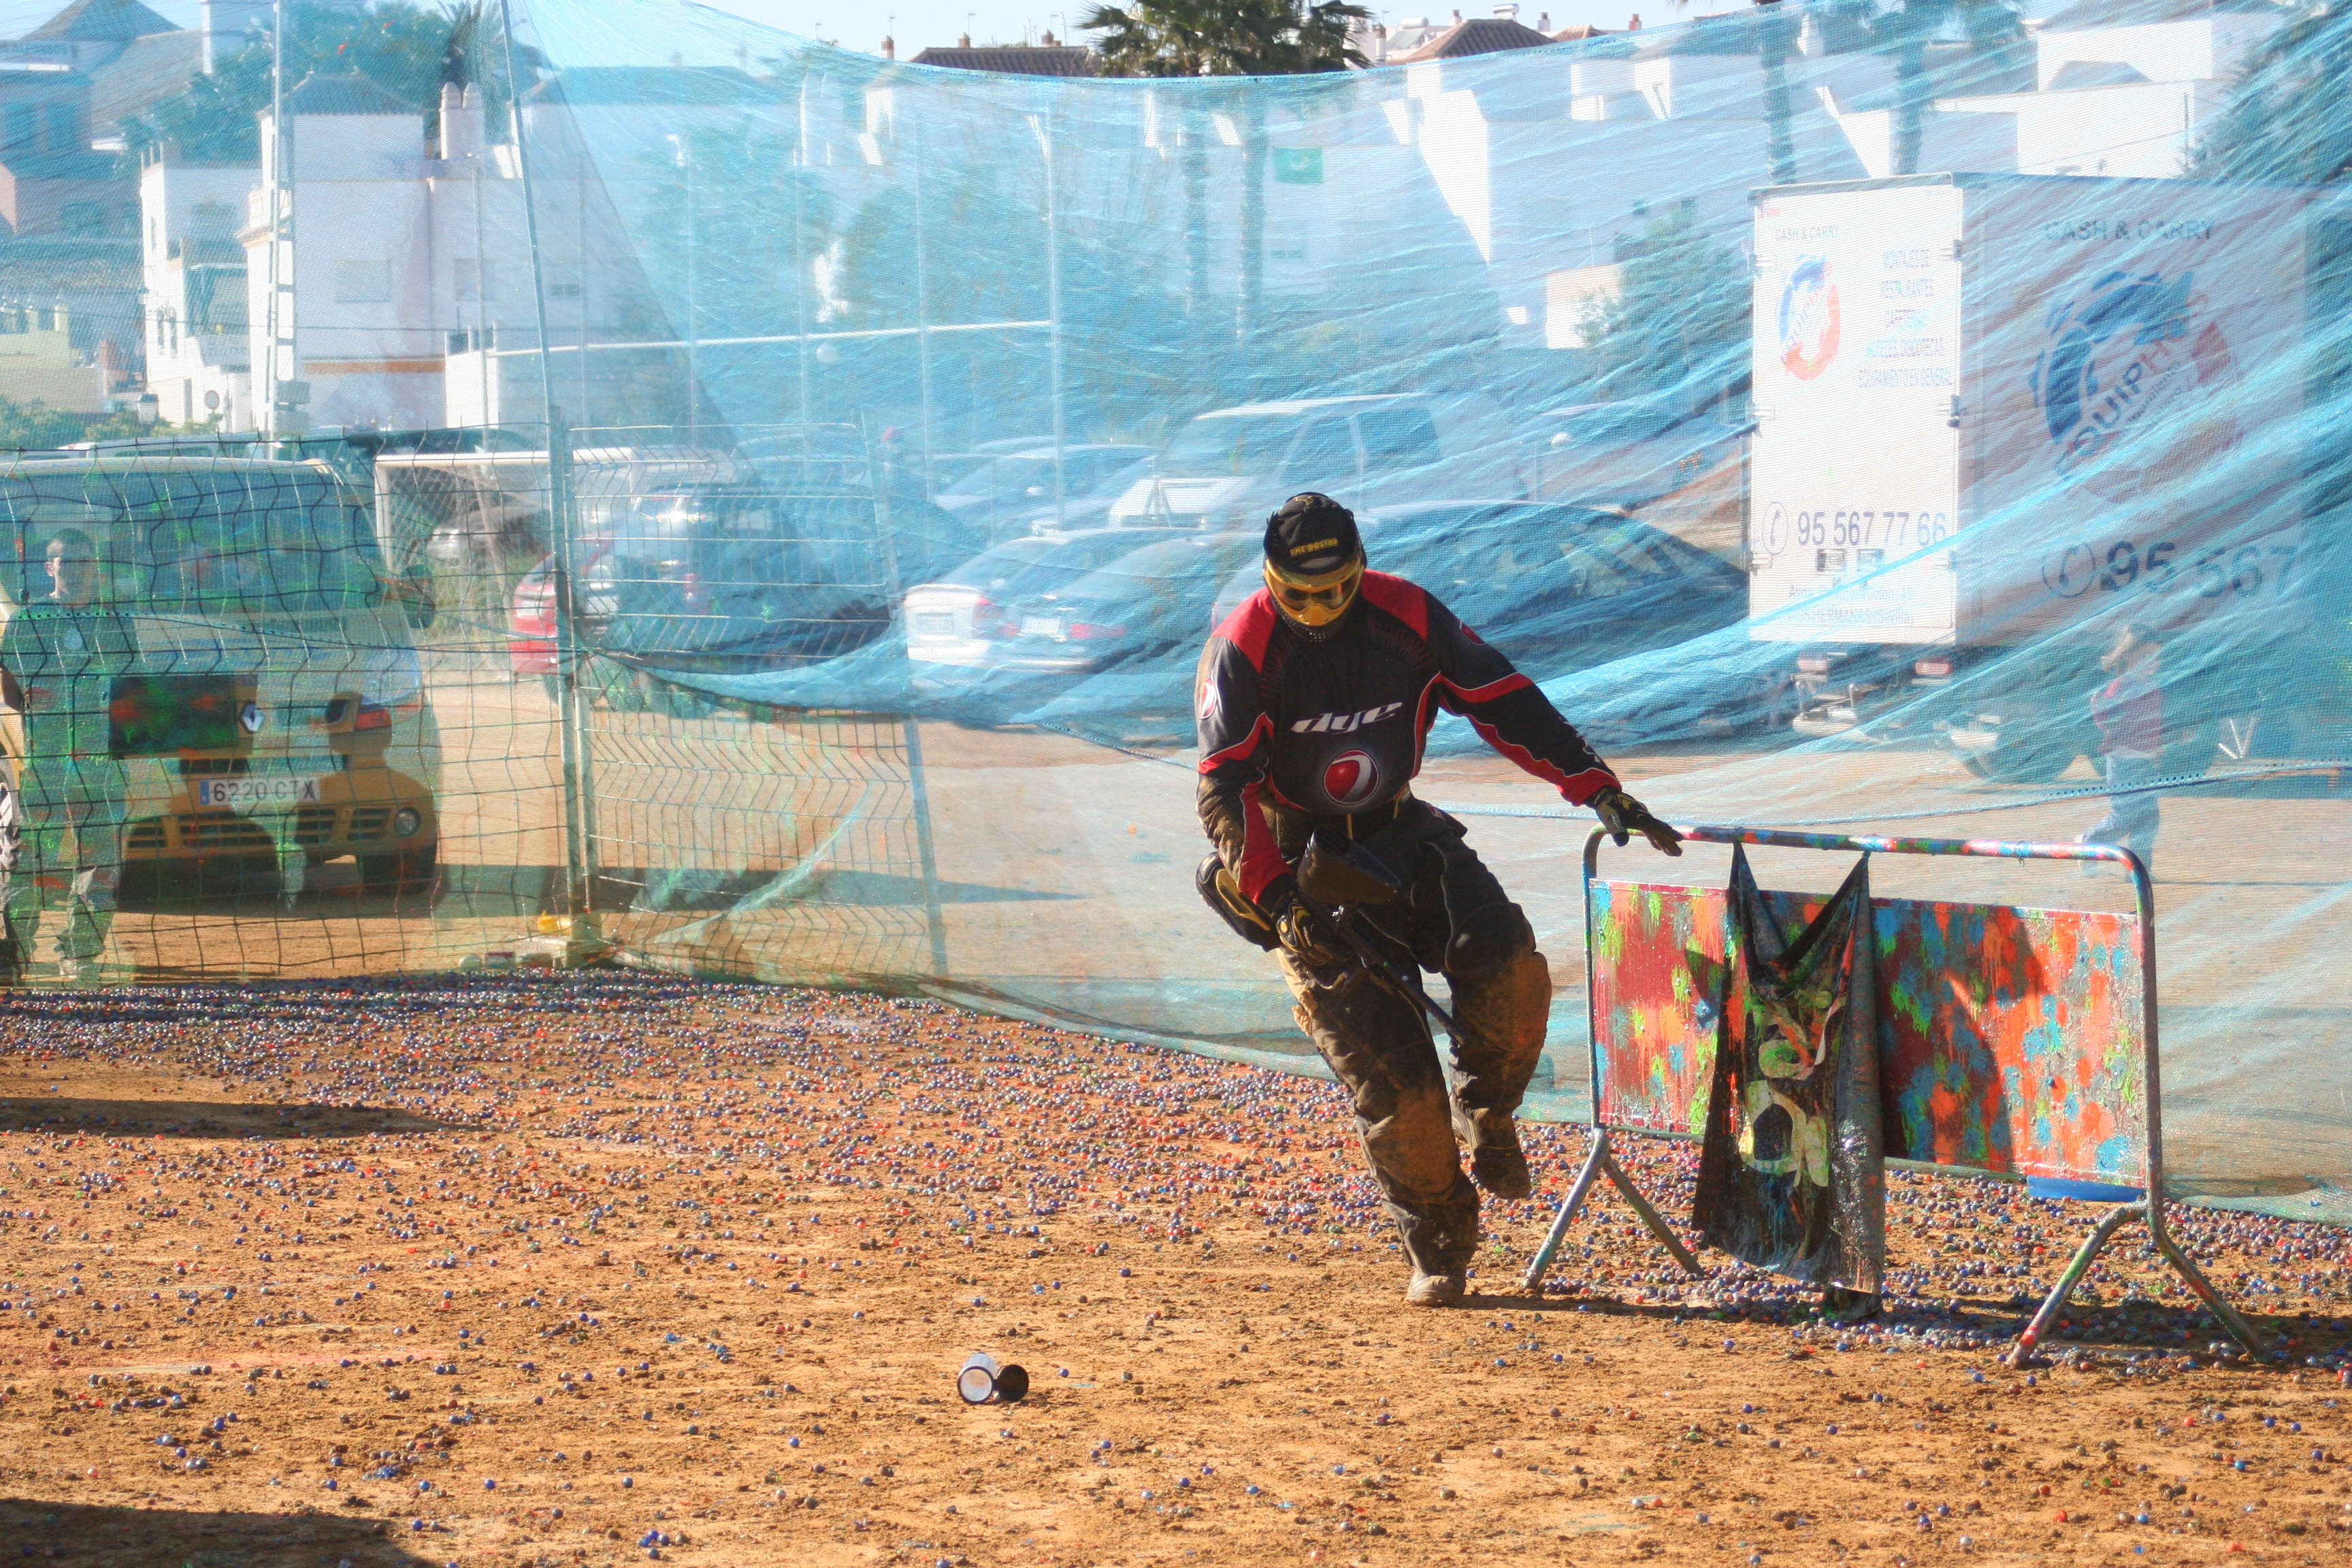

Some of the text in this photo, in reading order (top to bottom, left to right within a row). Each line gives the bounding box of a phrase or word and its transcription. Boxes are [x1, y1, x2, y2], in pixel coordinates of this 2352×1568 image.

[1774, 224, 1840, 242] CASH & CARRY
[2044, 218, 2217, 240] CASH & CARRY
[1797, 511, 1947, 548] 95 567 77 66
[1289, 537, 1339, 557] THE DOCTOR
[2107, 540, 2300, 598] 95 567
[1290, 702, 1403, 735] dye
[213, 781, 267, 802] 6220
